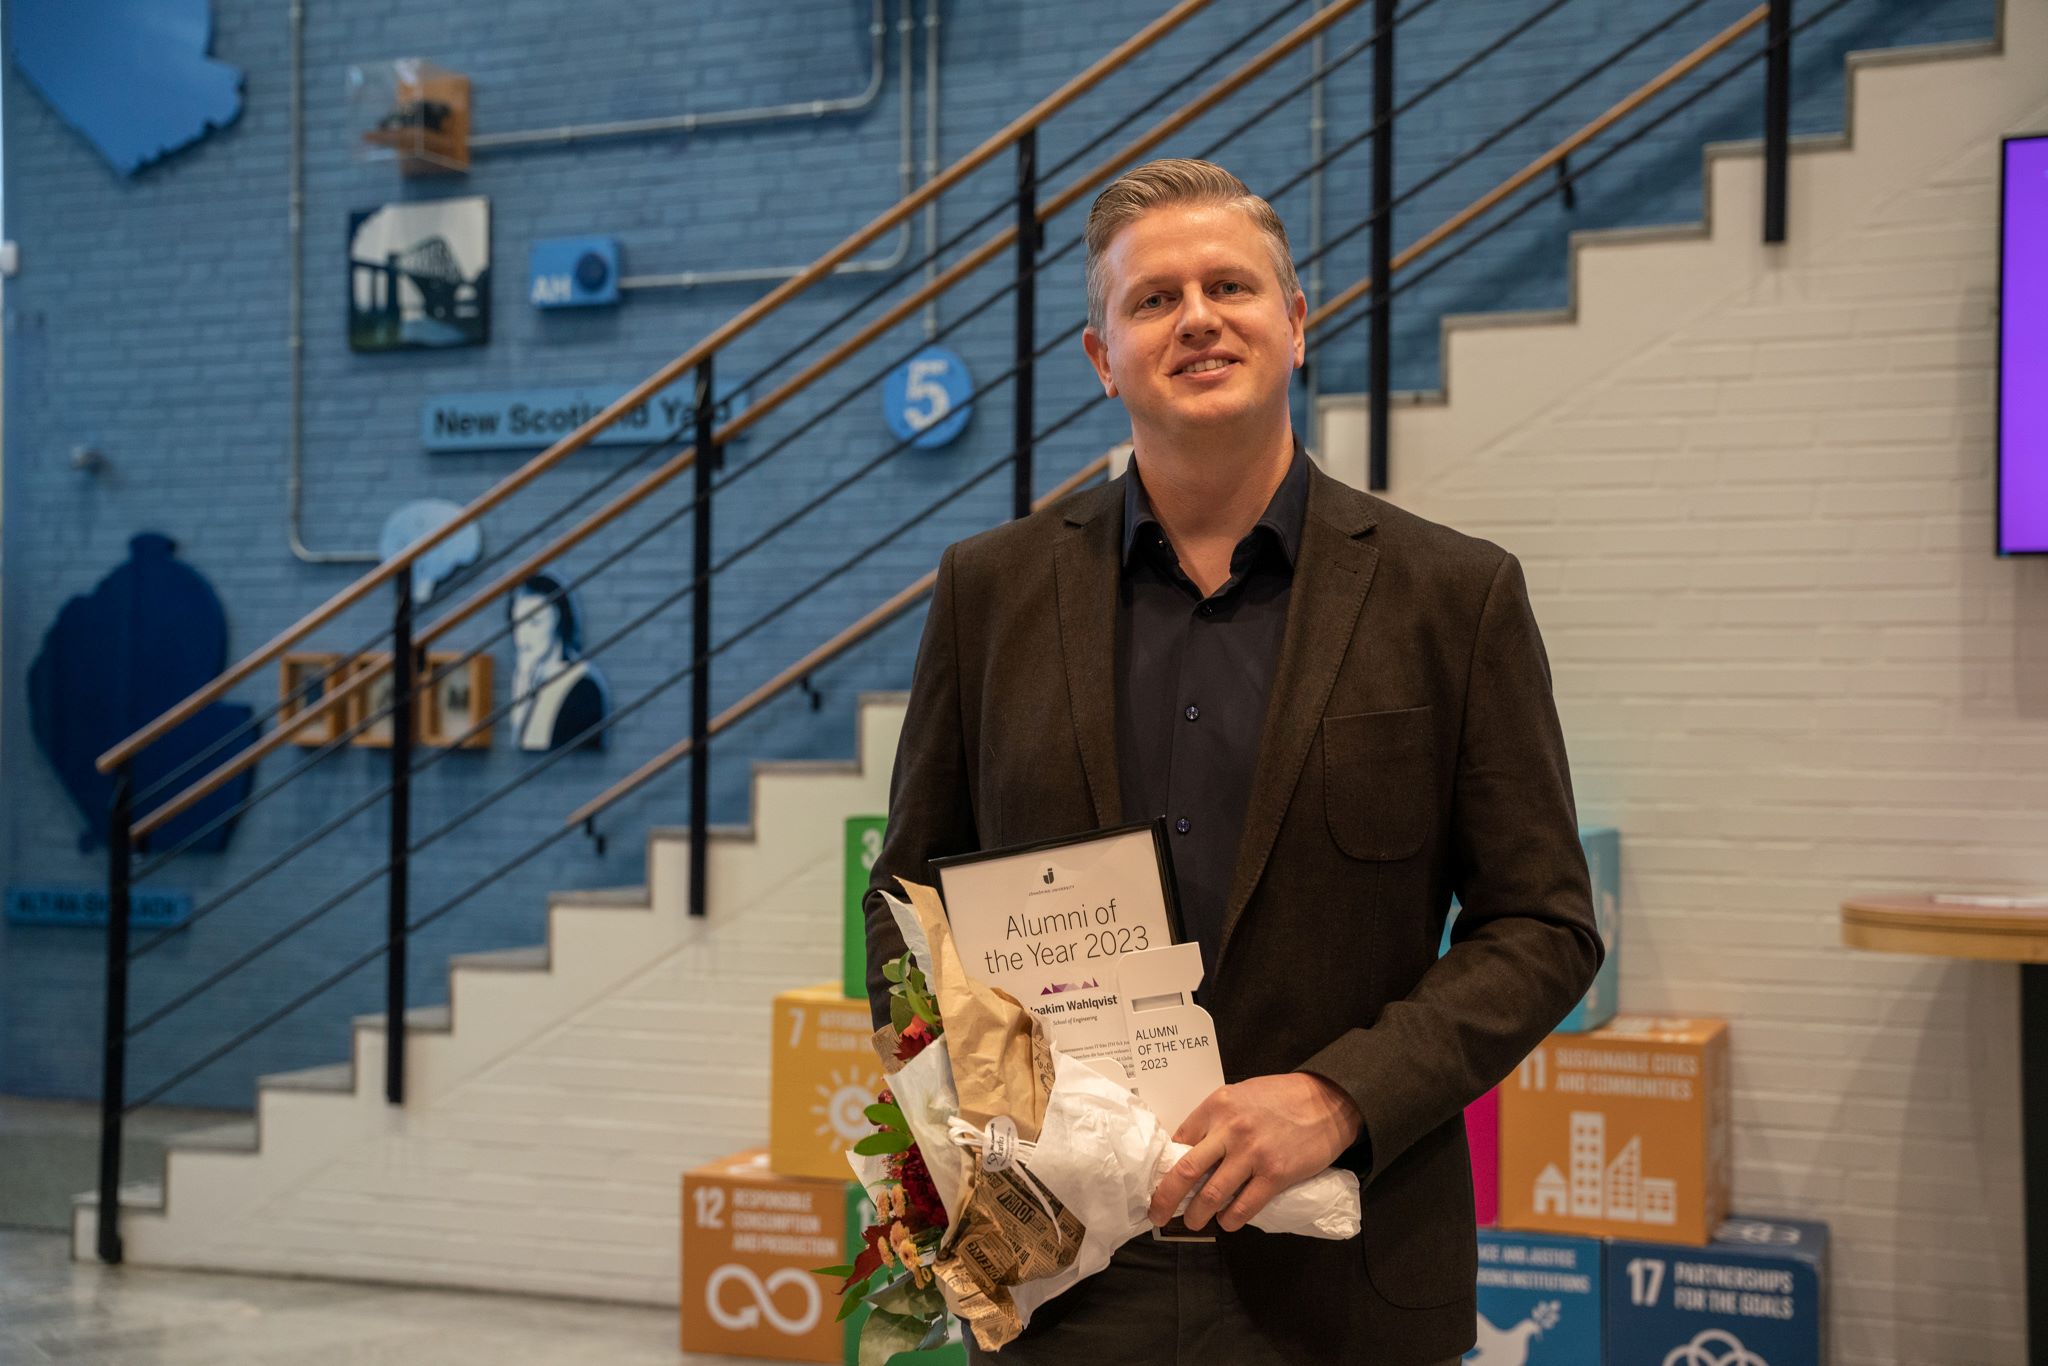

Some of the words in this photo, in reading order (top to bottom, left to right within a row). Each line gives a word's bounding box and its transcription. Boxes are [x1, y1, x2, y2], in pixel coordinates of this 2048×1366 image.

[904, 360, 950, 431] 5
[434, 408, 499, 436] New
[861, 829, 883, 870] 3
[1006, 904, 1088, 940] Alumni
[1095, 898, 1117, 925] of
[984, 949, 1023, 974] the
[1026, 942, 1078, 966] Year
[1084, 925, 1149, 959] 2023
[1066, 994, 1119, 1011] Wahlqvist
[788, 1007, 804, 1049] 7
[1135, 1024, 1178, 1040] ALUMNI
[1137, 1043, 1152, 1056] OF
[1154, 1040, 1178, 1053] THE
[1179, 1035, 1210, 1049] YEAR
[1140, 1057, 1168, 1071] 2023
[1519, 1047, 1547, 1091] 11
[1555, 1048, 1649, 1072] SUSTAINABLE
[1652, 1053, 1698, 1076] CITIES
[1556, 1072, 1585, 1093] AND
[1589, 1074, 1693, 1100] COMMUNITIES
[693, 1186, 726, 1229] 12
[732, 1188, 813, 1212] RESPONSIBLE
[732, 1211, 821, 1233] CONSUMPTION
[732, 1232, 757, 1252] AND
[760, 1234, 838, 1257] PRODUCTION
[1503, 1246, 1526, 1265] AND
[1529, 1247, 1576, 1269] JUSTICE
[1627, 1258, 1666, 1307] 17
[1674, 1261, 1794, 1294] PARTNERSHIPS
[1674, 1286, 1707, 1312] FOR
[1709, 1289, 1737, 1315] THE
[1739, 1292, 1794, 1320] GOALS
